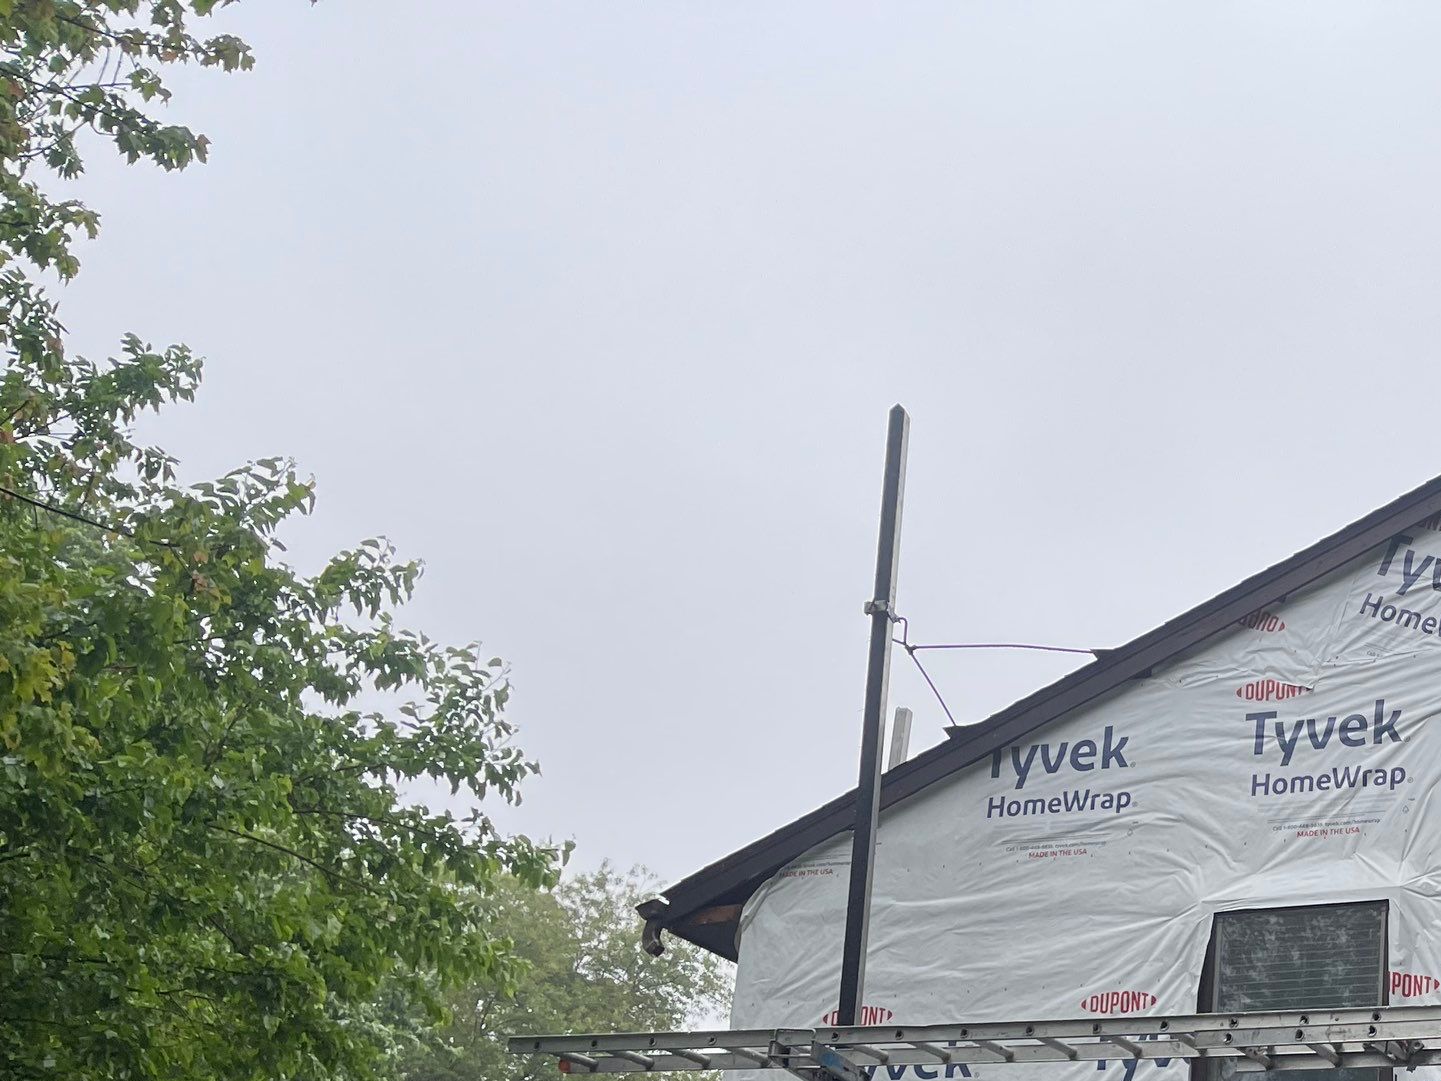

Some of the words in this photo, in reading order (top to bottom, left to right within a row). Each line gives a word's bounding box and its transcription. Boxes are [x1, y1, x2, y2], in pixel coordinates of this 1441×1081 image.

[1245, 699, 1404, 767] Tyvek
[1251, 765, 1407, 796] HomeWrap
[986, 789, 1132, 819] HomeWrap
[1296, 830, 1319, 838] MADE
[1345, 826, 1360, 834] USA
[1028, 851, 1048, 859] MADE
[1387, 971, 1432, 998] PONT
[1090, 990, 1149, 1014] DUPONT
[831, 1006, 886, 1026] DONT
